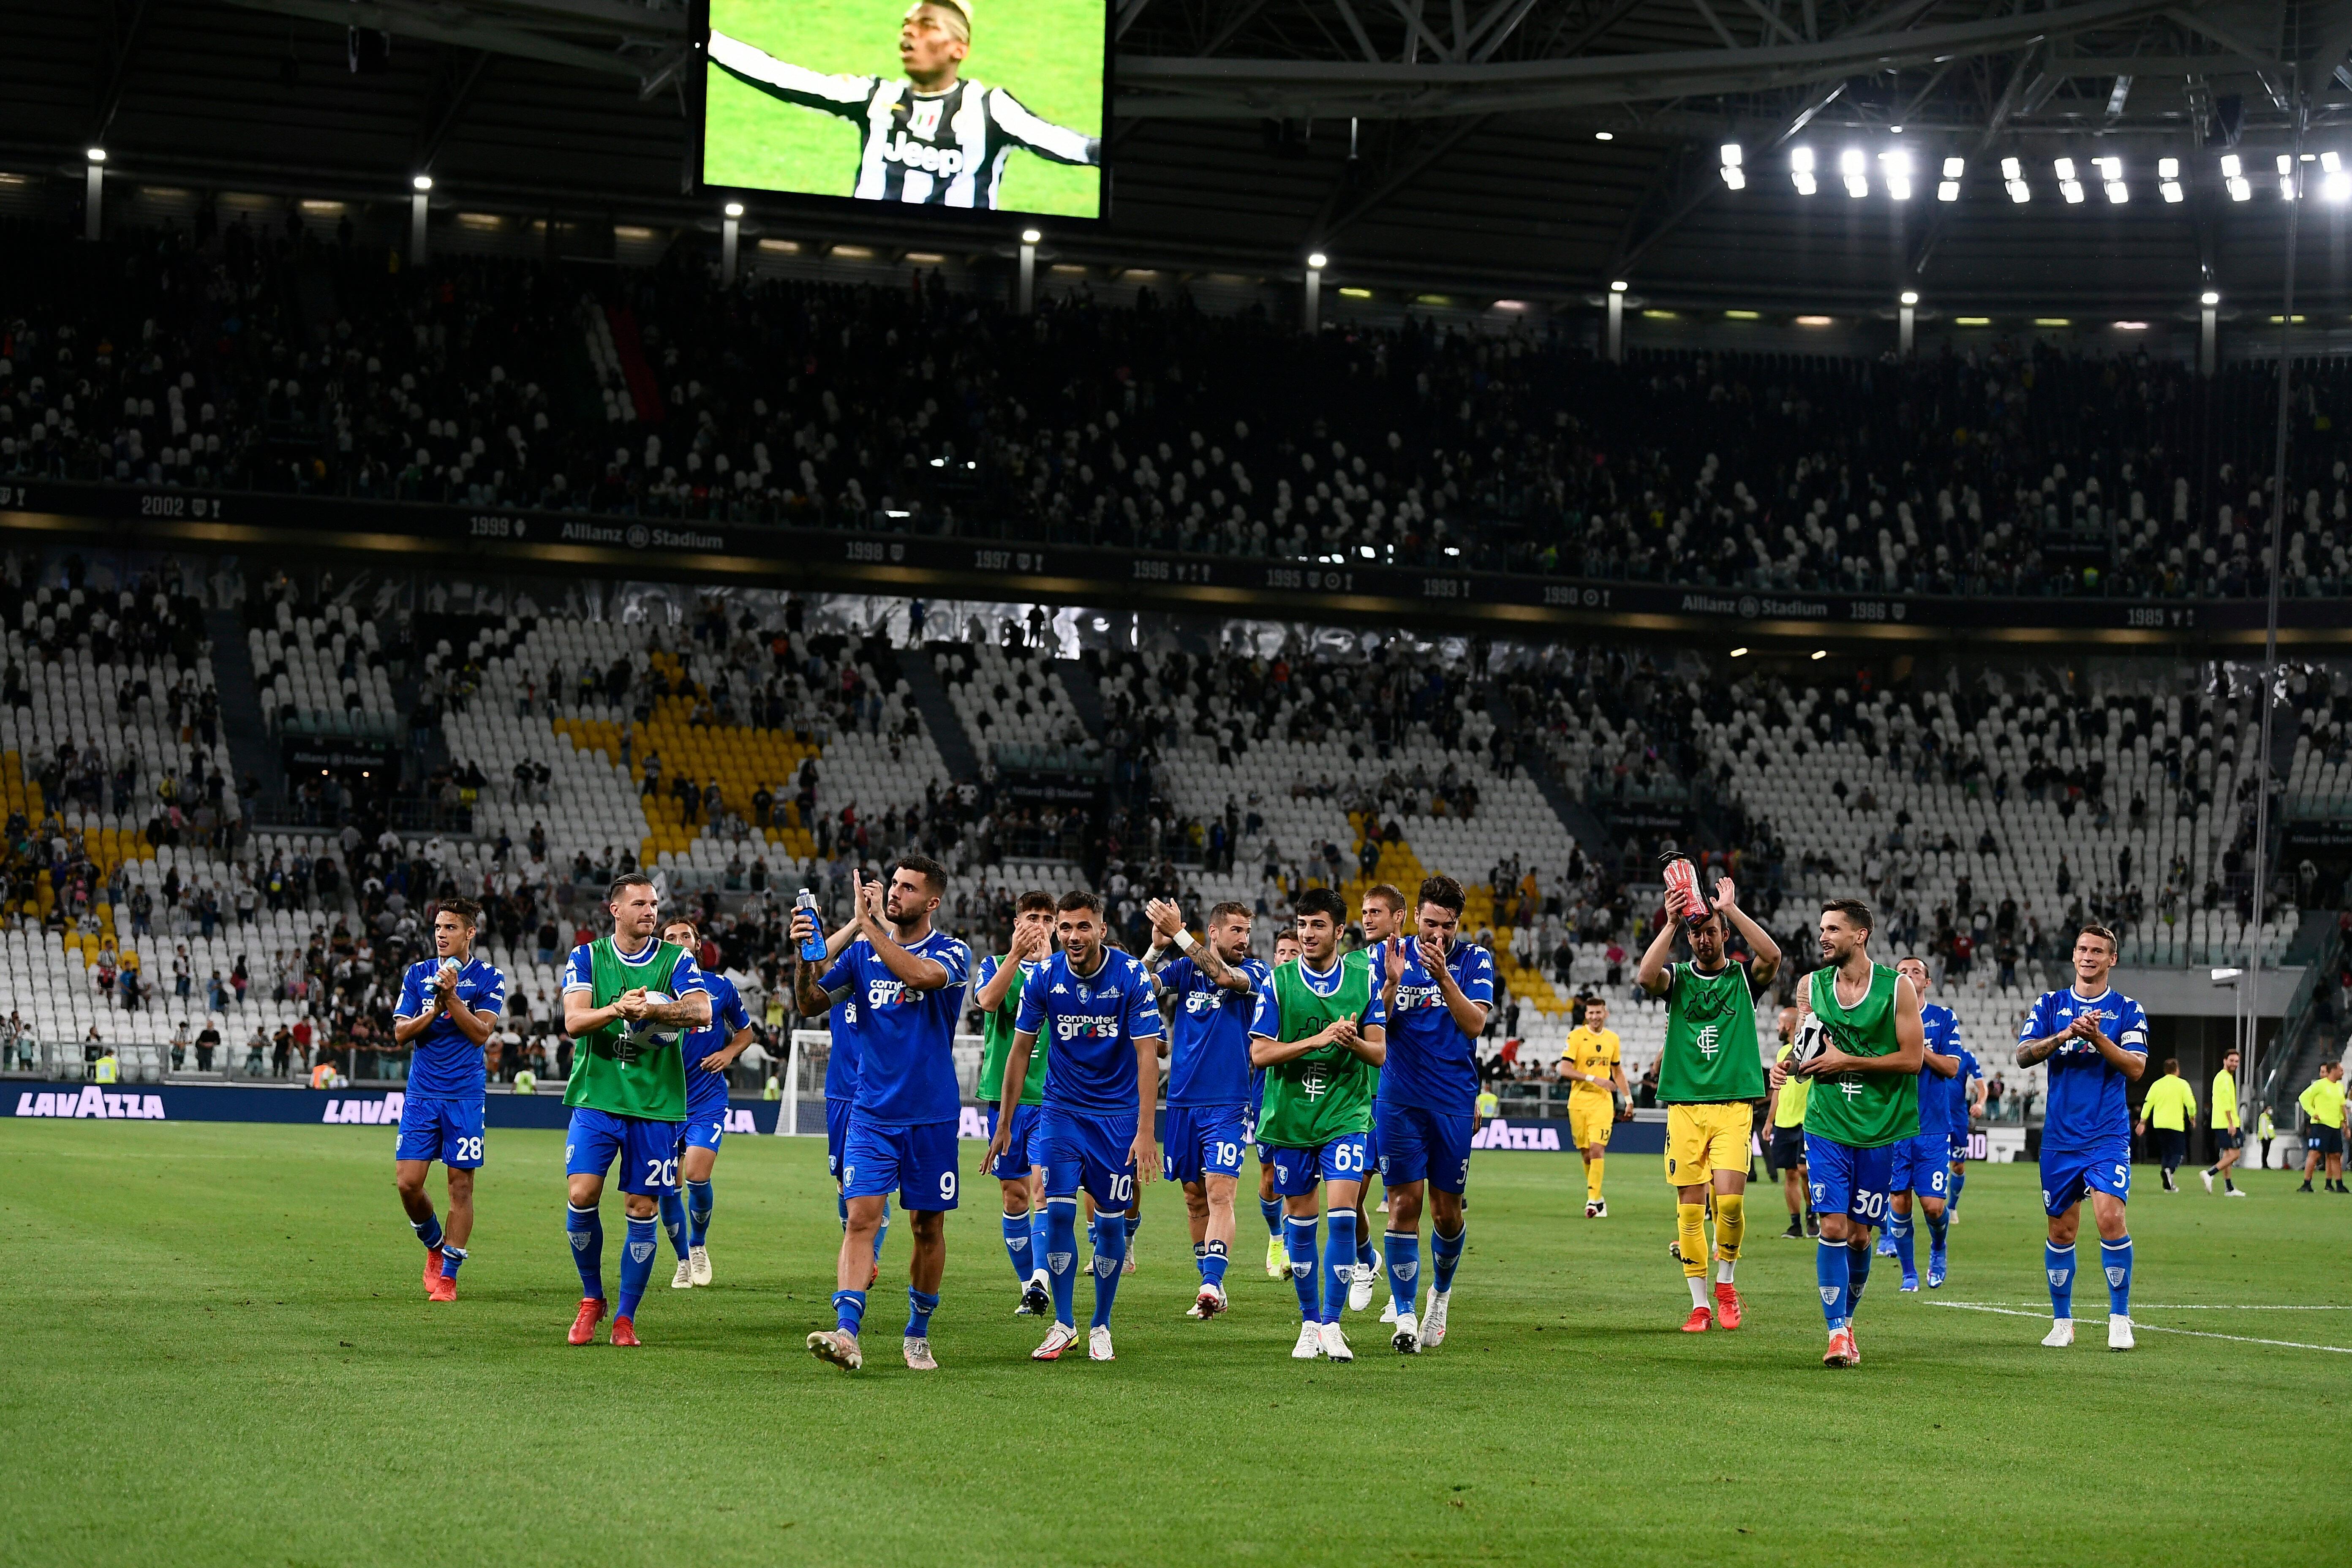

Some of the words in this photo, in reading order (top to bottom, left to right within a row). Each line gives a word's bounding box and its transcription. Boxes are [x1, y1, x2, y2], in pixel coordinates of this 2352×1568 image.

[884, 131, 964, 178] Jeep
[142, 495, 185, 517] 2002
[469, 516, 509, 537] 1999
[561, 522, 623, 542] Allianz
[651, 528, 724, 549] Stadium
[846, 541, 884, 561] 1998
[974, 550, 1011, 570] 1997
[1682, 595, 1735, 613] Allianz
[1761, 599, 1828, 618] Stadium
[1057, 1014, 1117, 1024] computer
[1057, 1022, 1119, 1040] gross
[16, 1085, 165, 1119] LAVAZZA
[709, 1122, 722, 1143] 7
[1600, 1128, 1609, 1140] 13
[457, 1136, 482, 1160] 28
[1216, 1141, 1237, 1166] 19
[1335, 1143, 1363, 1173] 65
[1952, 1146, 1965, 1158] 27
[645, 1159, 673, 1186] 20
[1932, 1171, 1944, 1192] 8
[2112, 1164, 2127, 1188] 5
[939, 1171, 955, 1200] 9
[1109, 1173, 1131, 1201] 10
[1853, 1189, 1883, 1218] 30
